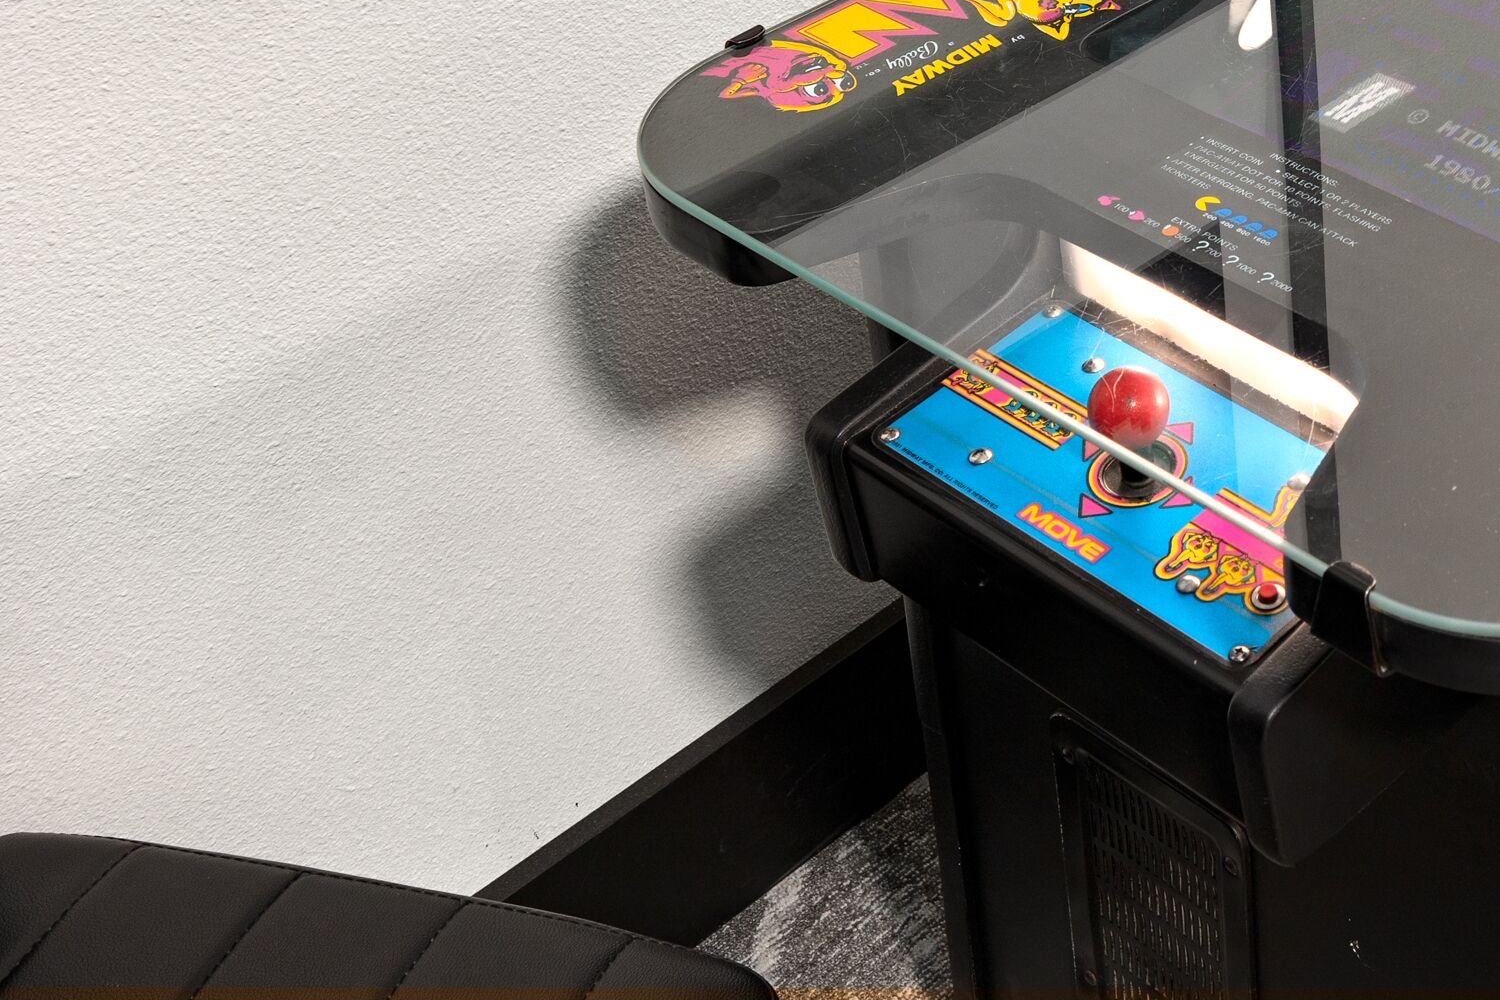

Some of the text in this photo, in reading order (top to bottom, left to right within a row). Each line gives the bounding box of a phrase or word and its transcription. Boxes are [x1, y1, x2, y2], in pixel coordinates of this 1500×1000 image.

[885, 40, 938, 69] Bally
[892, 33, 1003, 97] MIDWAY
[1160, 164, 1212, 190] MONSTERS
[1184, 151, 1236, 176] ENERGIZER
[1235, 173, 1256, 186] FOR
[1254, 182, 1267, 191] 50
[1206, 138, 1264, 166] INSERT COIN
[1171, 158, 1201, 174] AFTER
[1255, 197, 1299, 220] PAC-MAN
[1298, 217, 1320, 230] CAN
[1319, 227, 1359, 248] ATTACK
[1194, 145, 1244, 169] PAC-AWAY
[1242, 166, 1264, 178] DOT
[1262, 175, 1284, 188] FOR
[1284, 185, 1295, 193] 10
[1332, 207, 1381, 233] FLASHING
[1282, 172, 1319, 191] SELECT
[1326, 192, 1342, 202] OR
[1348, 202, 1393, 226] PLAYERS
[1113, 203, 1129, 213] 100
[1236, 263, 1257, 275] 1000
[1171, 216, 1238, 251] EXTRA POINTS
[902, 447, 923, 462] MIDWAY
[944, 474, 953, 482] ALL
[954, 479, 972, 493] RIGHTS
[972, 490, 999, 510] RESERVED
[1016, 502, 1112, 563] MOVE
